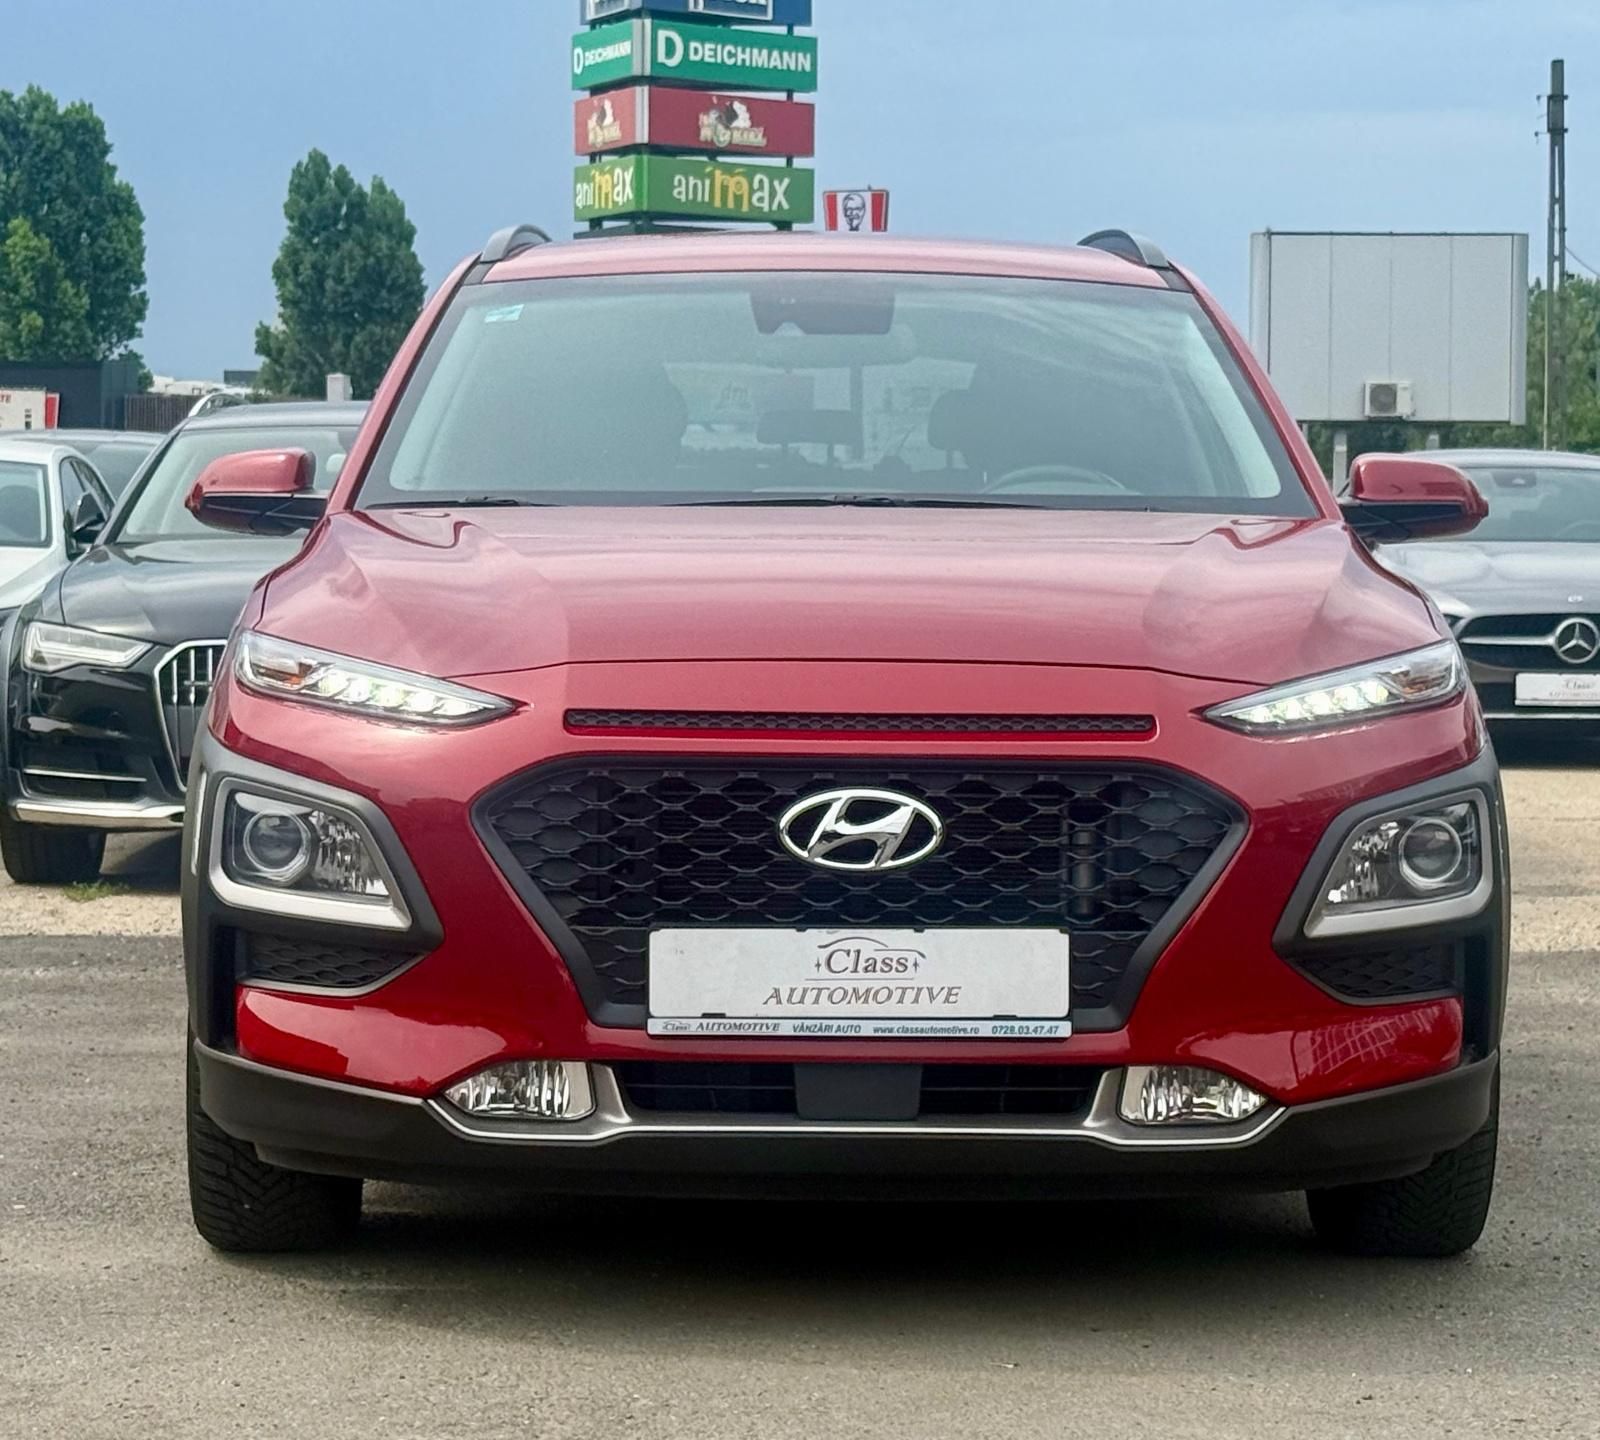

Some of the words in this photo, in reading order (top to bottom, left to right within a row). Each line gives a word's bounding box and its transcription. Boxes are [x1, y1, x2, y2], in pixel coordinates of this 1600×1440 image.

[573, 46, 584, 75] D
[584, 40, 632, 67] DEICHMANN
[656, 29, 684, 68] D
[688, 40, 812, 72] DEICHMANN
[575, 164, 634, 210] animax
[672, 166, 791, 213] animax
[826, 948, 909, 975] Class
[762, 985, 963, 1006] AUTOMOTIVE
[695, 1022, 782, 1032] AUTOMOTIVE
[835, 1023, 863, 1034] AUTO
[872, 1025, 980, 1035] www.classautomotive.ro
